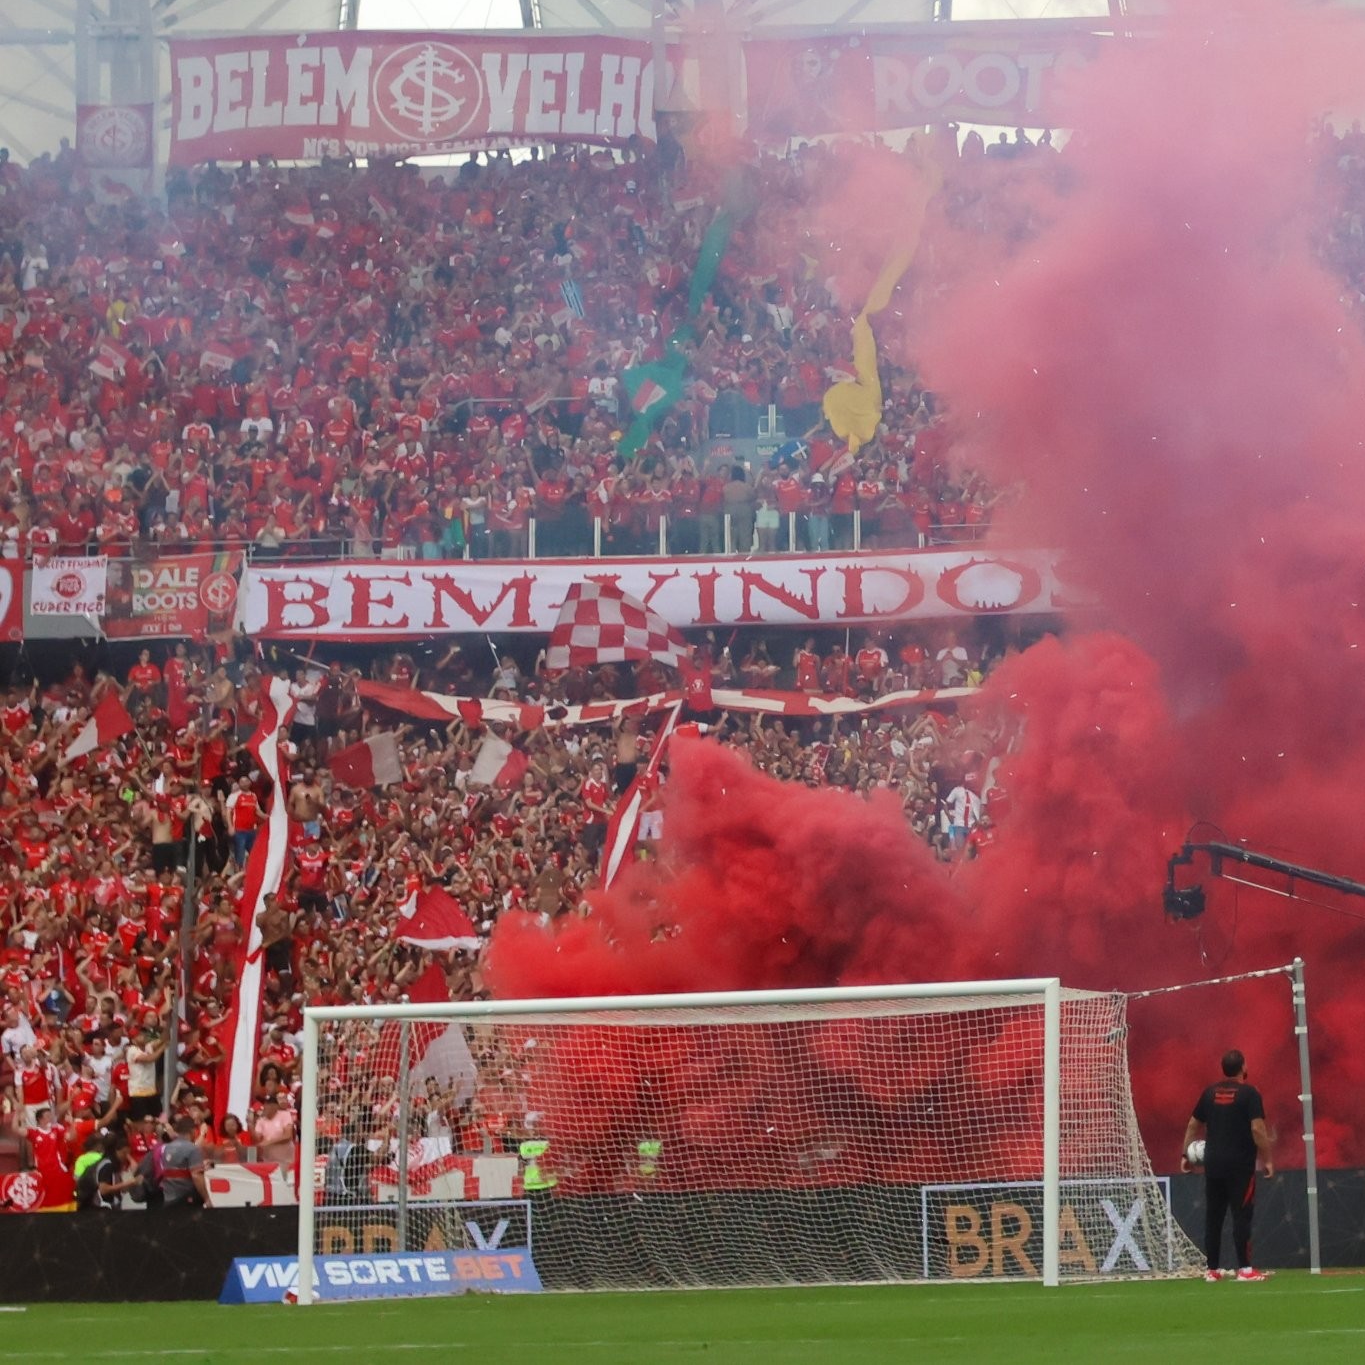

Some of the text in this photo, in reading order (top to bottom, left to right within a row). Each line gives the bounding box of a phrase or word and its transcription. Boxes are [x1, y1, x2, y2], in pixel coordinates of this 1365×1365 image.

[177, 35, 372, 140] BELÉM
[132, 591, 198, 611] ROOTS
[945, 1198, 1151, 1277] BRAX
